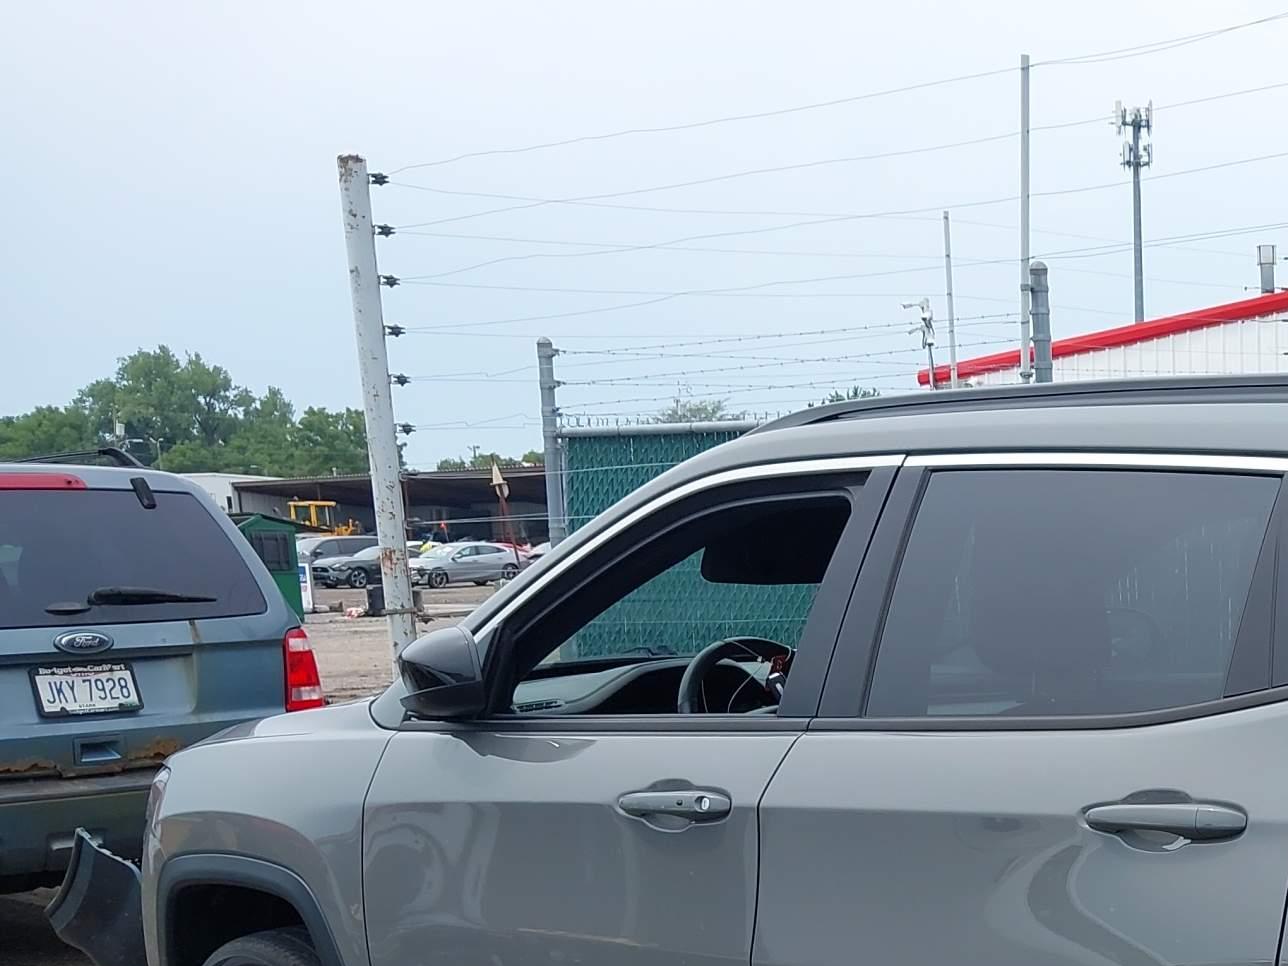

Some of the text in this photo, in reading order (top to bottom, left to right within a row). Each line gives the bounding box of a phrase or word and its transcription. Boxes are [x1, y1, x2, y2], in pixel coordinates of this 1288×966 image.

[74, 636, 99, 648] Ford
[47, 677, 131, 704] JKY 7928
